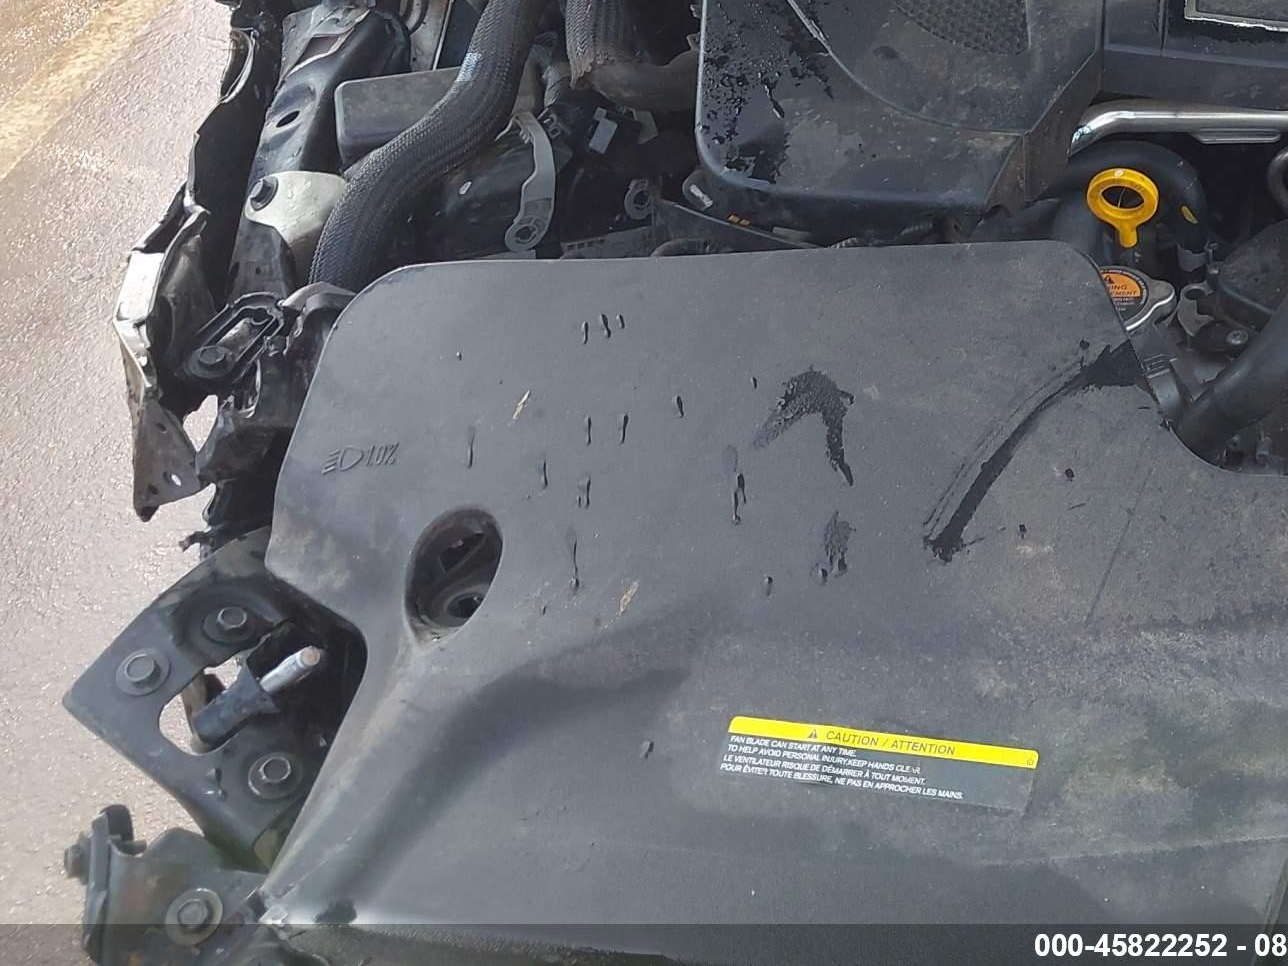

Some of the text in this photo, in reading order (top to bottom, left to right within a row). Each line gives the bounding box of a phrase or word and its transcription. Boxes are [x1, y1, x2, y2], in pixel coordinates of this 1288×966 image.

[730, 735, 746, 744] FAN
[745, 737, 770, 747] BLADE
[770, 740, 788, 749] CAN
[787, 742, 811, 751] START
[810, 744, 821, 752] AT
[820, 745, 838, 754] ANY
[826, 730, 879, 746] CAUTION
[891, 739, 956, 755] ATTENTION
[723, 754, 734, 762] LE
[734, 755, 782, 768] VENTILATEUR
[781, 761, 810, 771] RISQUE
[809, 763, 821, 772] DE
[821, 765, 864, 778] DÉMARRER
[871, 771, 892, 781] TOUT
[728, 744, 738, 752] TO
[738, 745, 759, 754] HELP
[758, 748, 782, 757] AVOID
[781, 750, 821, 762] PERSONAL
[867, 761, 896, 771] HANDS
[720, 762, 743, 772] POUR
[769, 768, 794, 779] TOUTE
[834, 776, 847, 785] NE
[846, 778, 863, 787] PAS
[862, 780, 875, 789] EN
[874, 782, 923, 795] APPROCHER
[922, 787, 938, 797] LES
